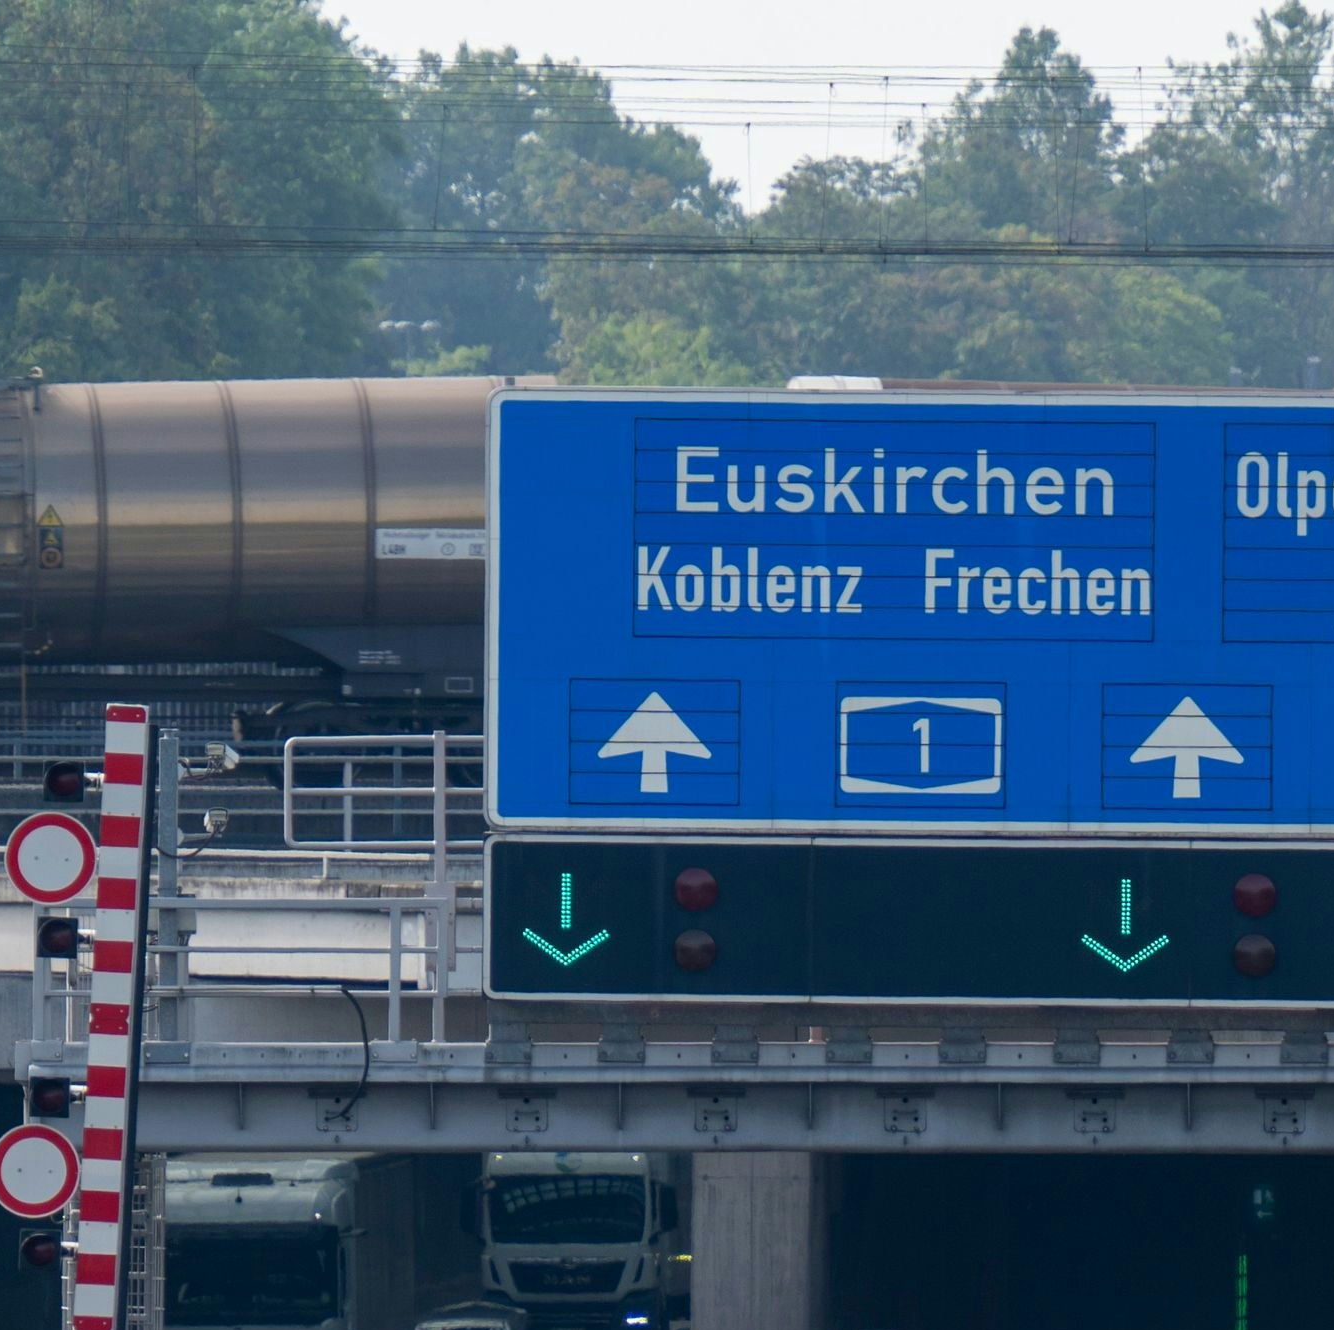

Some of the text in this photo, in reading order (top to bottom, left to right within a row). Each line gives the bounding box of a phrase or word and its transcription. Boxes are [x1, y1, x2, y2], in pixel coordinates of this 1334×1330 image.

[676, 446, 1114, 515] Euskirchen
[637, 546, 1150, 616] Koblenz Frechen
[912, 718, 929, 774] 1
